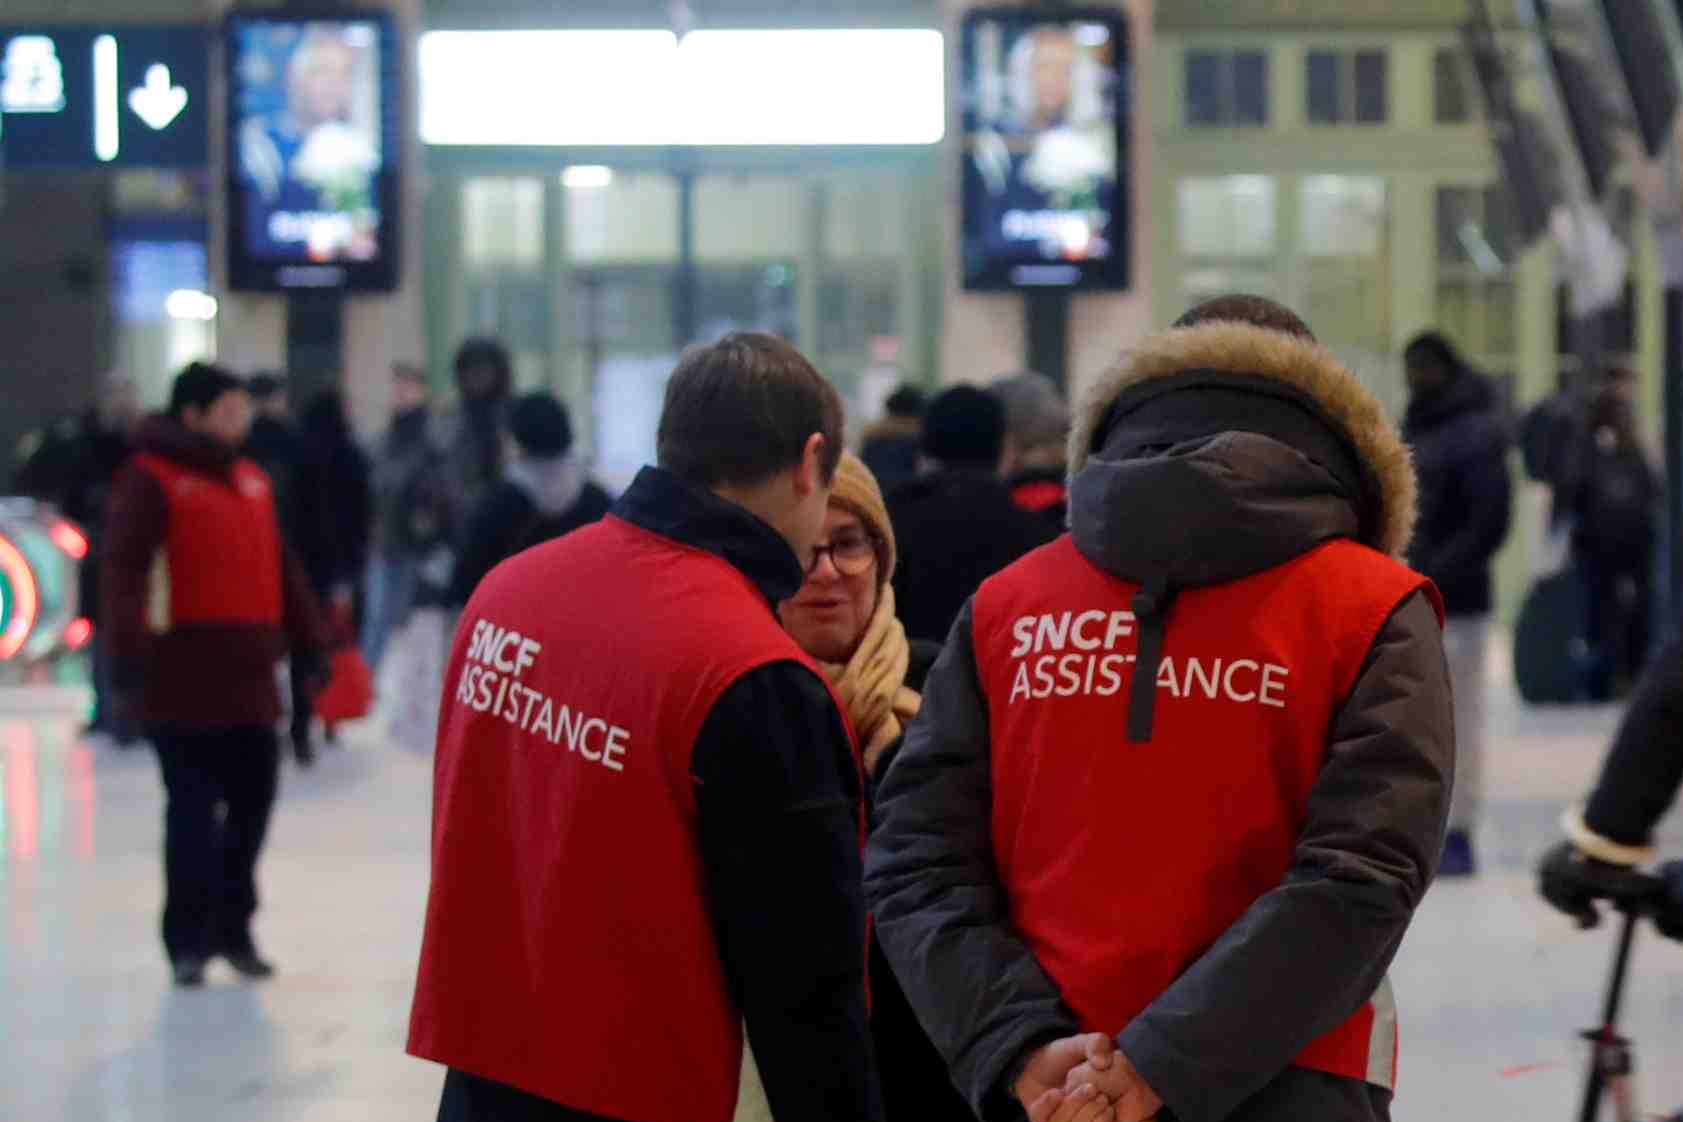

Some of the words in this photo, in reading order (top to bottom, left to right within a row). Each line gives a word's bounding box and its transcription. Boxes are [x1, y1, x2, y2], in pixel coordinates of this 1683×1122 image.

[467, 618, 542, 677] SNCF
[1010, 609, 1136, 657] SNCF
[1008, 653, 1289, 708] ASSISANCE
[456, 663, 631, 772] ASSISTANCE
